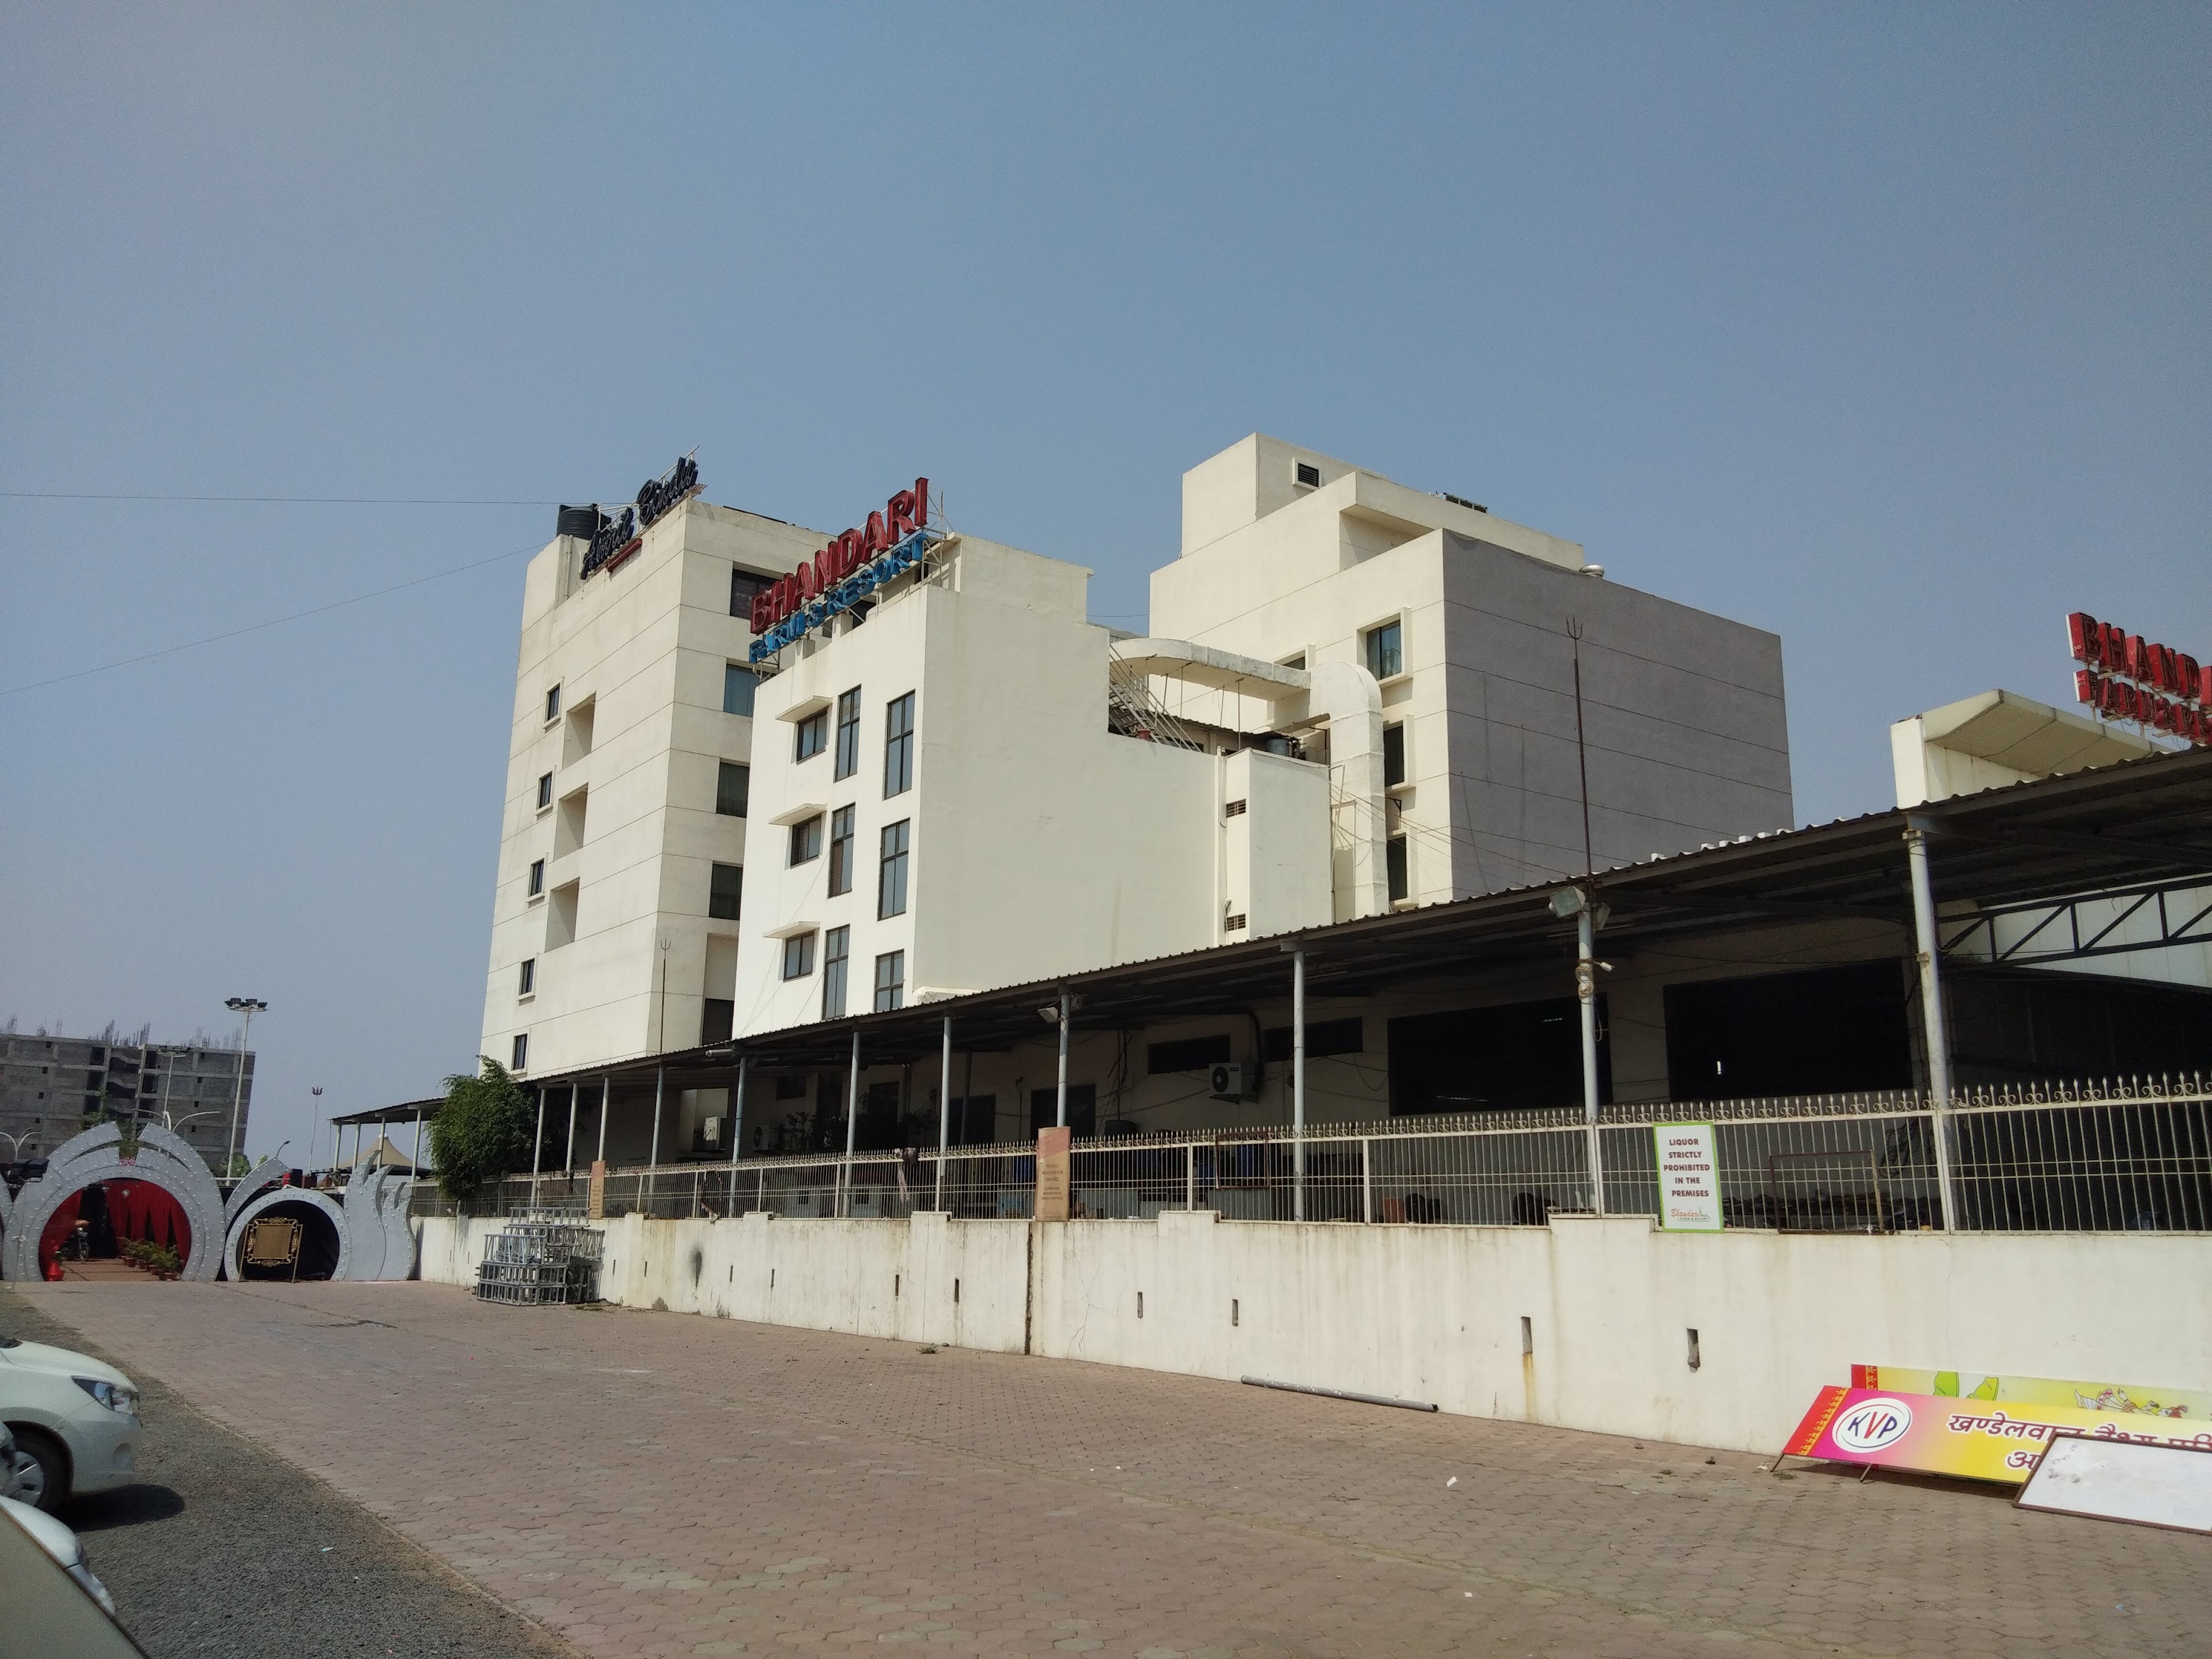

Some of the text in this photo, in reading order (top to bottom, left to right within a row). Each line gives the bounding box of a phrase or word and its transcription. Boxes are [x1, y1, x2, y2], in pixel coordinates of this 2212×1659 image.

[751, 477, 929, 636] BHANDARI
[749, 532, 928, 664] FARM & RESORT
[2066, 612, 2212, 711] BHAND
[2073, 669, 2157, 724] FARM
[1847, 1411, 1897, 1439] KVP
[1948, 1412, 2086, 1442] खण्डेलवा
